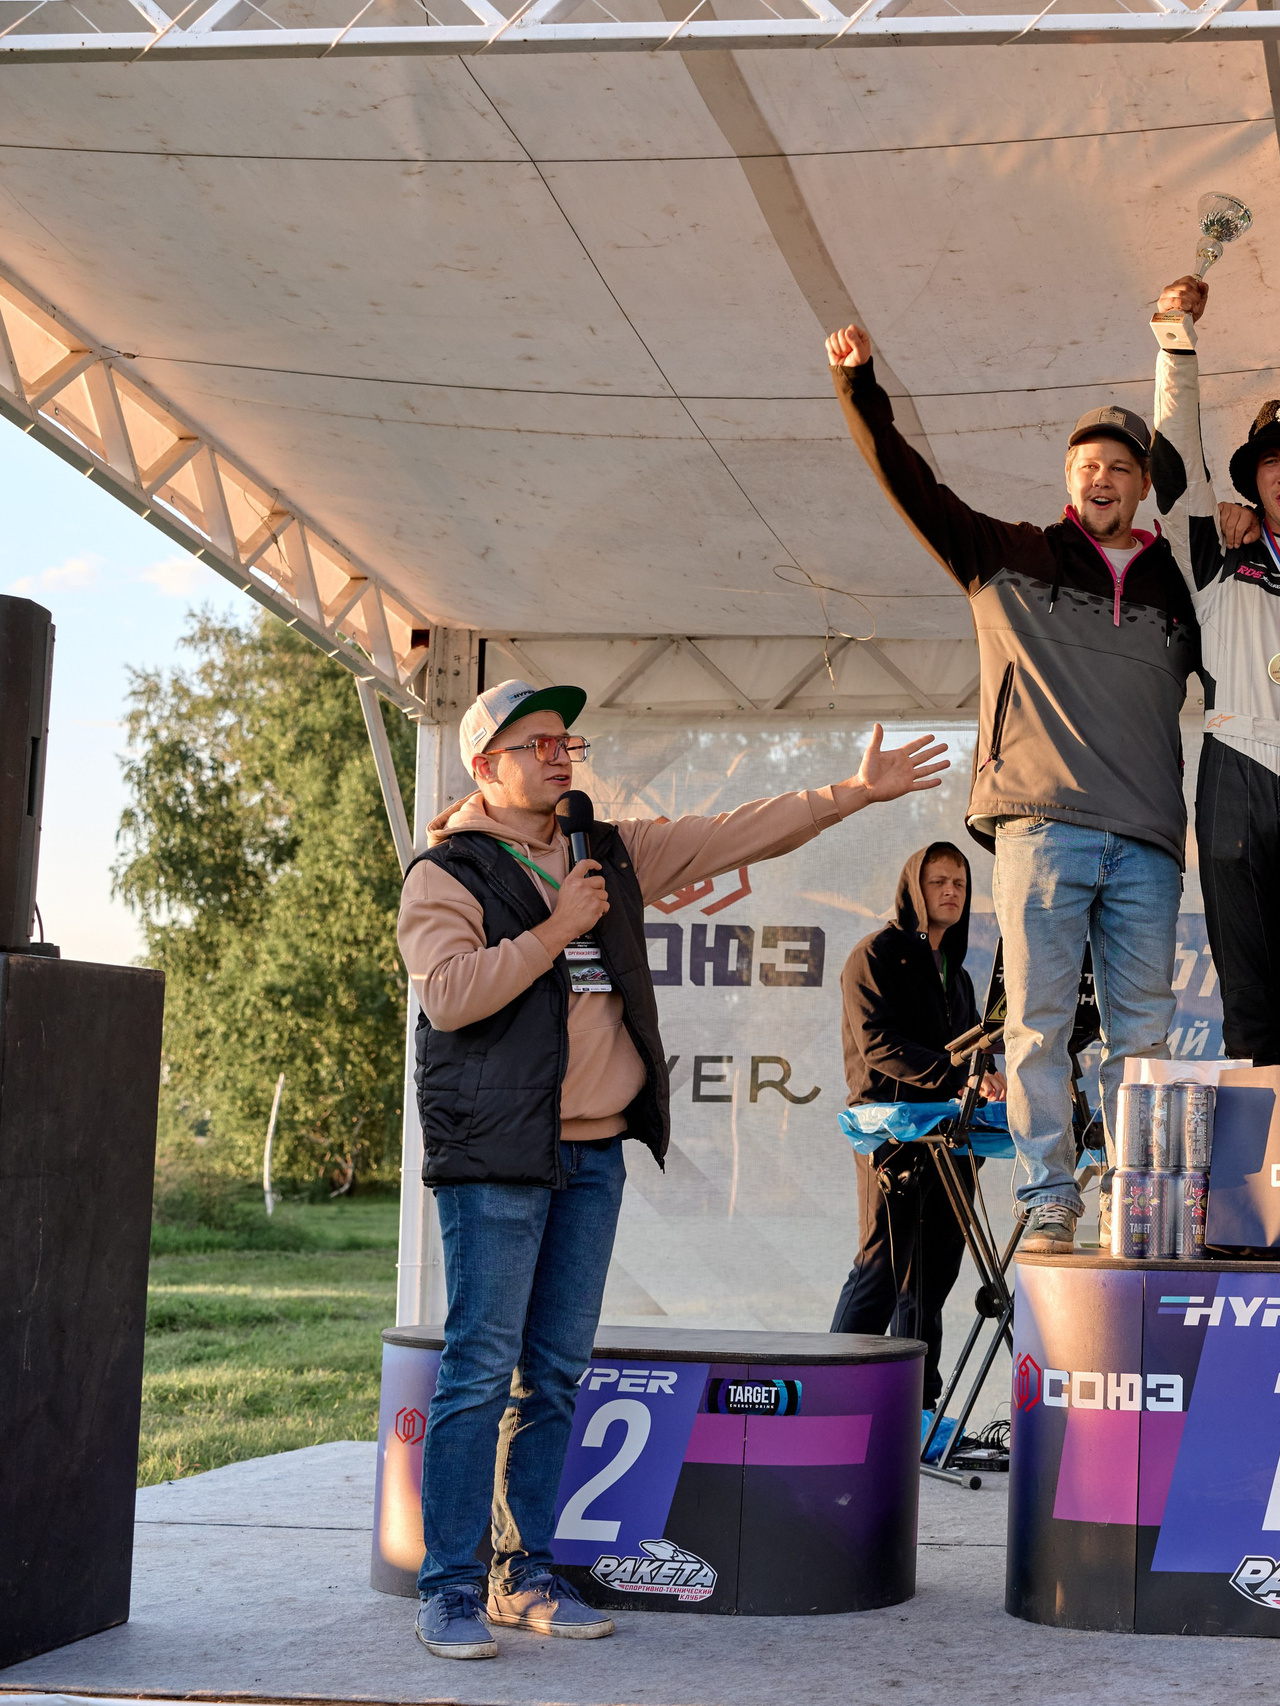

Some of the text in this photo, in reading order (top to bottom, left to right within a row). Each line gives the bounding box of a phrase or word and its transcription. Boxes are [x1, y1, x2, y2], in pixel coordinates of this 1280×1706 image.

[1237, 565, 1266, 579] RDS
[644, 922, 826, 987] ОЮЗ
[728, 1385, 777, 1404] TARGET
[1043, 1368, 1184, 1412] СОЮЗ
[554, 1399, 652, 1542] 2
[591, 1556, 716, 1588] РАКЕТА
[624, 1584, 713, 1595] СПОРТИВНО-ТЕХНИЧЕСКИЙ
